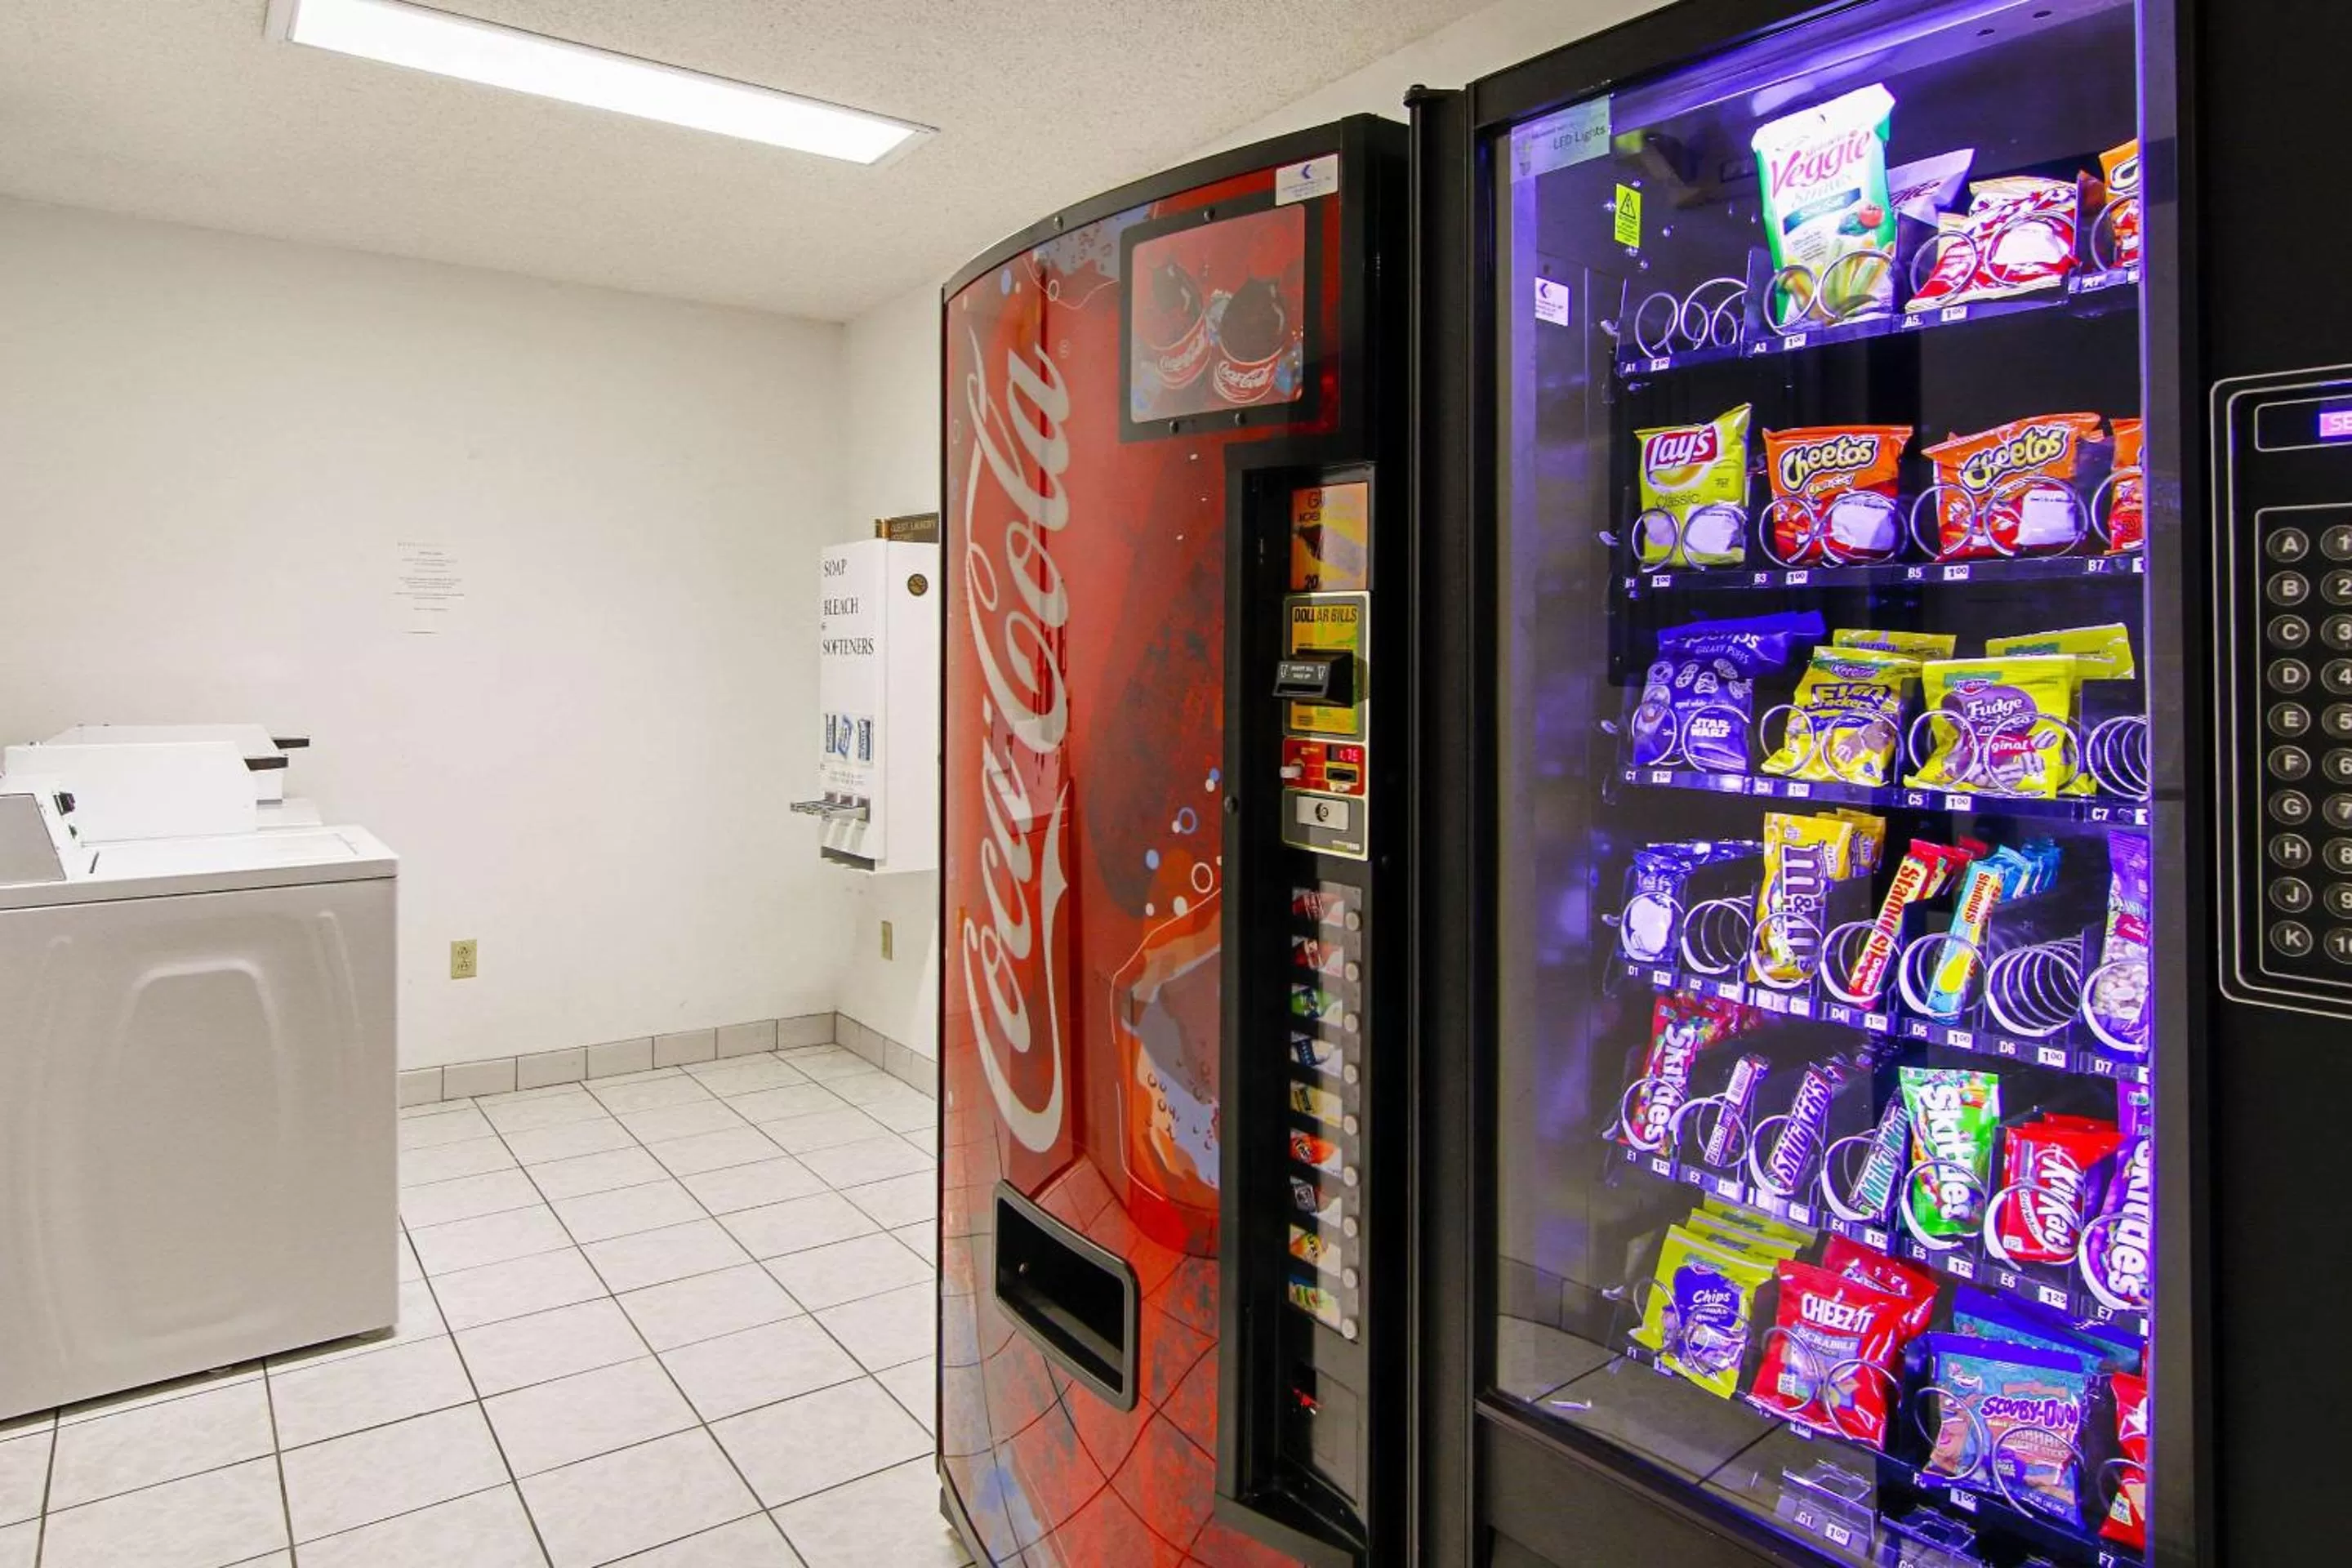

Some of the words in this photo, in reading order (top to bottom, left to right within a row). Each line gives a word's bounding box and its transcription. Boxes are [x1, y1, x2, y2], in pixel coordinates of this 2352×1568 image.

[1552, 135, 1572, 150] LED
[1771, 129, 1870, 198] Veggie
[1781, 436, 1878, 492] Cheetos
[1962, 425, 2069, 492] Cheetos
[1655, 492, 1701, 508] Classic
[2281, 536, 2299, 553] A
[2338, 533, 2351, 552] 1
[823, 559, 848, 577] SOAP
[2087, 559, 2105, 572] B7
[2282, 580, 2299, 597] B
[2338, 578, 2352, 595] 2
[823, 597, 858, 615] BLEACH
[1294, 608, 1329, 623] DOLLAR
[1330, 607, 1357, 622] BILLS
[2282, 623, 2300, 641] C
[2337, 623, 2352, 641] 3
[822, 638, 875, 655] SOFTENERS
[2283, 667, 2300, 684] D
[2338, 667, 2352, 685] 4
[1967, 698, 2023, 718] Fudge
[1694, 718, 1731, 728] STAR
[2283, 711, 2299, 728] E
[2338, 712, 2352, 730] 5
[962, 328, 1071, 1154] Coca-Cola
[1690, 727, 1731, 738] WARS
[2284, 755, 2299, 771] F
[2339, 756, 2352, 775] 6
[1908, 794, 1923, 805] C5
[2283, 798, 2301, 815] G
[2091, 808, 2109, 821] C7
[2339, 802, 2352, 819] 7
[2285, 843, 2301, 859] H
[2341, 845, 2352, 864] 8
[2285, 886, 2299, 903] J
[2341, 891, 2352, 910] 9
[2286, 929, 2302, 947] K
[1999, 1040, 2016, 1054] D6
[2095, 1060, 2112, 1074] D7
[1645, 1023, 1697, 1142] Skittles
[1773, 1076, 1831, 1183] SNICKERS
[1919, 1085, 1980, 1219] Skittles
[1912, 1245, 1926, 1258] E5
[2001, 1272, 2016, 1287] E6
[1692, 1289, 1731, 1305] Chips
[2047, 1291, 2066, 1303] 125
[2097, 1306, 2113, 1320] E7
[1798, 1511, 1814, 1526] G1
